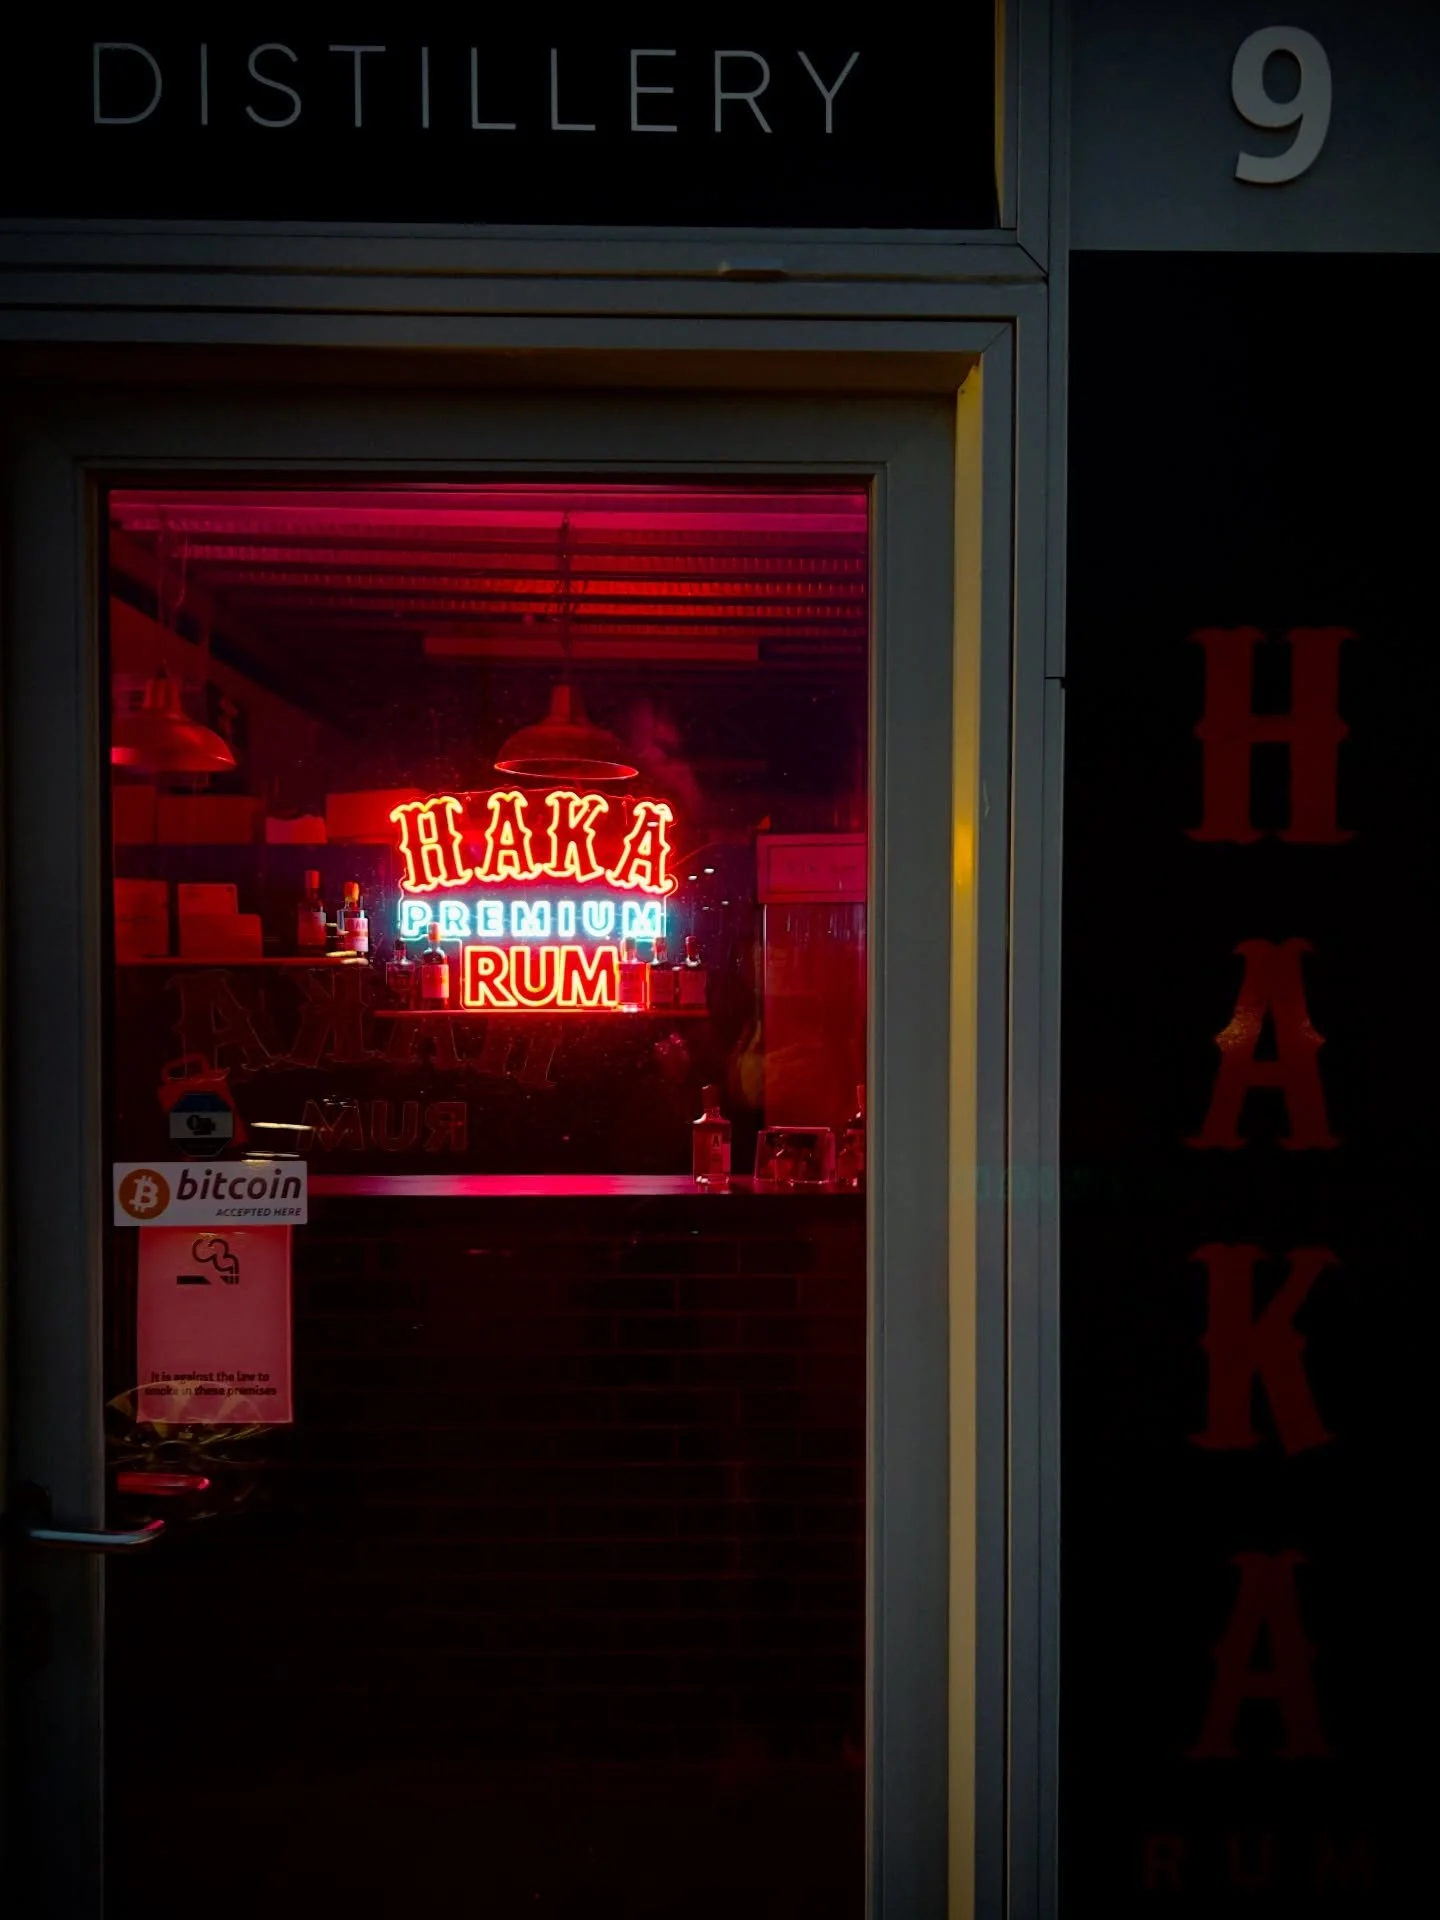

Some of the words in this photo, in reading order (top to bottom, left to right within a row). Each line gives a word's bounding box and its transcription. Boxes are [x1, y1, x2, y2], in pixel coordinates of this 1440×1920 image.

[91, 41, 862, 134] DISTILLERY
[1231, 24, 1333, 185] 9
[389, 790, 675, 894] HAKA
[401, 900, 663, 938] PREMIUM
[464, 945, 621, 1006] RUM
[175, 1168, 302, 1201] bitcoin
[215, 1207, 272, 1218] ACCEPTED
[273, 1206, 302, 1217] HERE
[1185, 625, 1357, 1762] HAKA
[161, 1371, 171, 1381] is
[173, 1371, 214, 1384] against
[216, 1371, 235, 1382] the
[237, 1370, 256, 1382] law
[258, 1372, 270, 1382] to
[194, 1385, 225, 1396] these
[227, 1384, 277, 1398] premises
[1137, 1831, 1374, 1891] RUM
